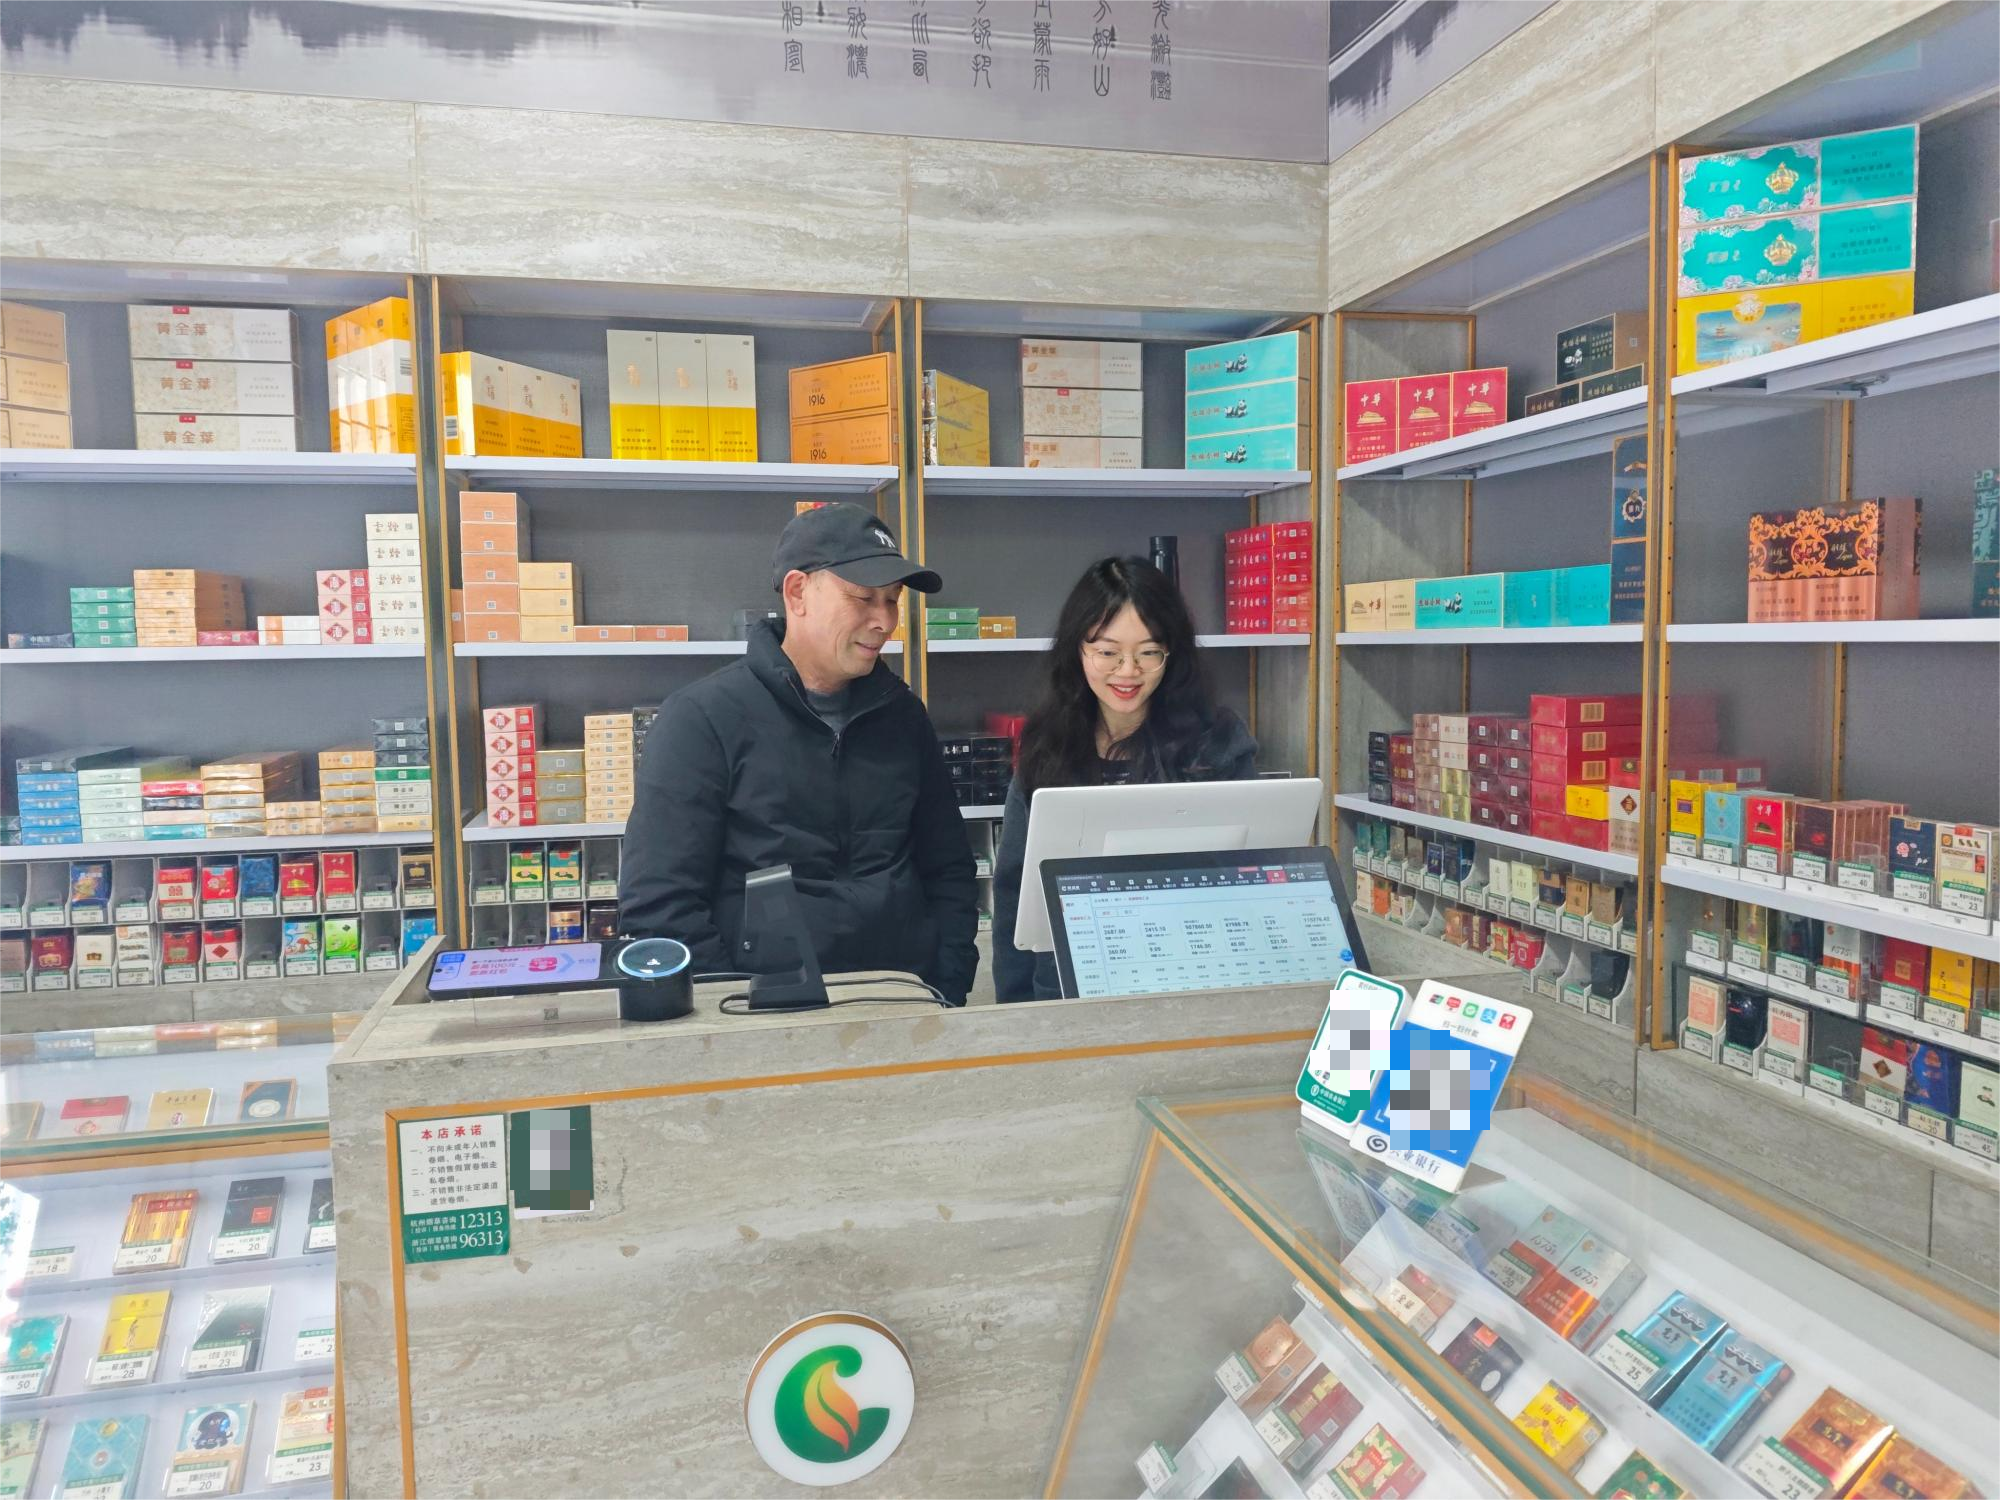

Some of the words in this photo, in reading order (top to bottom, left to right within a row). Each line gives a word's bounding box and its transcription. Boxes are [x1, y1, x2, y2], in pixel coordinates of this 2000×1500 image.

[808, 394, 826, 407] 1916
[810, 449, 827, 461] 1916
[1968, 901, 1978, 911] 23
[421, 1124, 483, 1141] 本店承诺
[1981, 1144, 1992, 1153] 45
[459, 1211, 503, 1230] 12313
[459, 1230, 504, 1248] 96313
[248, 1243, 260, 1251] 20
[145, 1255, 157, 1264] 20
[47, 1265, 58, 1273] 18
[218, 1358, 231, 1368] 23
[122, 1369, 135, 1380] 28
[1626, 1366, 1642, 1381] 25
[16, 1380, 30, 1391] 50
[308, 1462, 322, 1472] 23
[199, 1481, 213, 1490] 20
